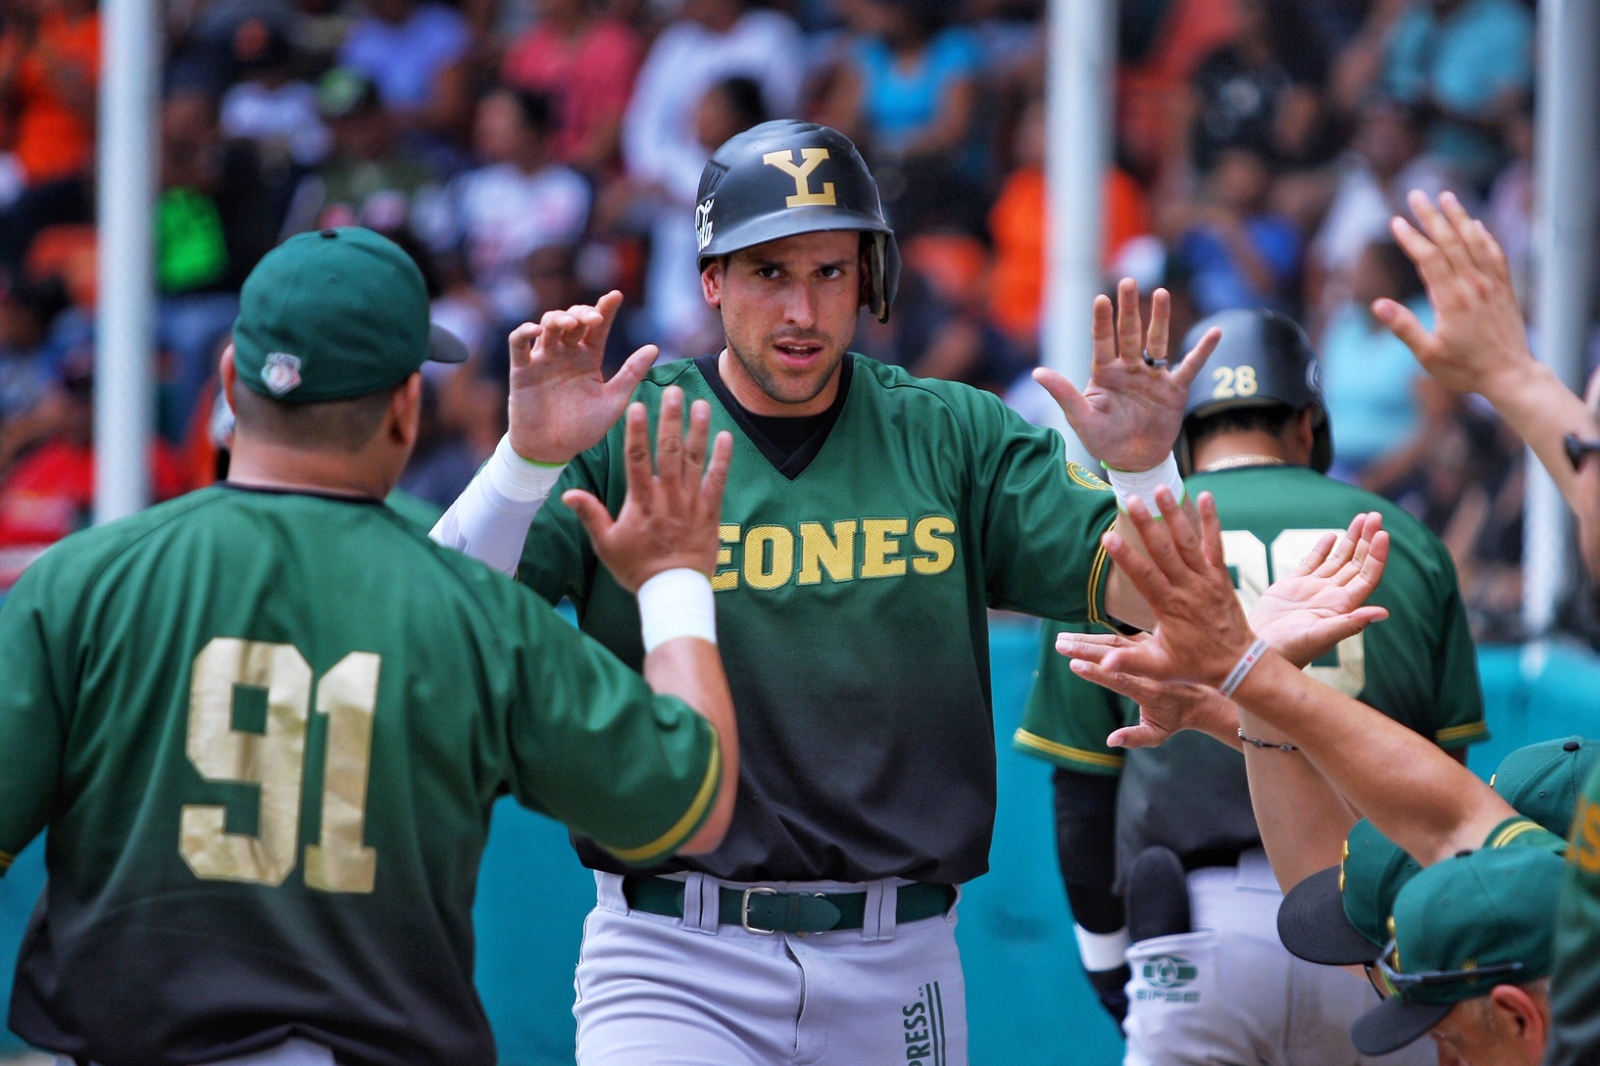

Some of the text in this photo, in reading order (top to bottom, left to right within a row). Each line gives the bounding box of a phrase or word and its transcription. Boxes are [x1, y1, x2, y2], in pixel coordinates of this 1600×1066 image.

[1211, 365, 1259, 399] 28
[710, 515, 957, 592] EONES
[178, 636, 382, 893] 91
